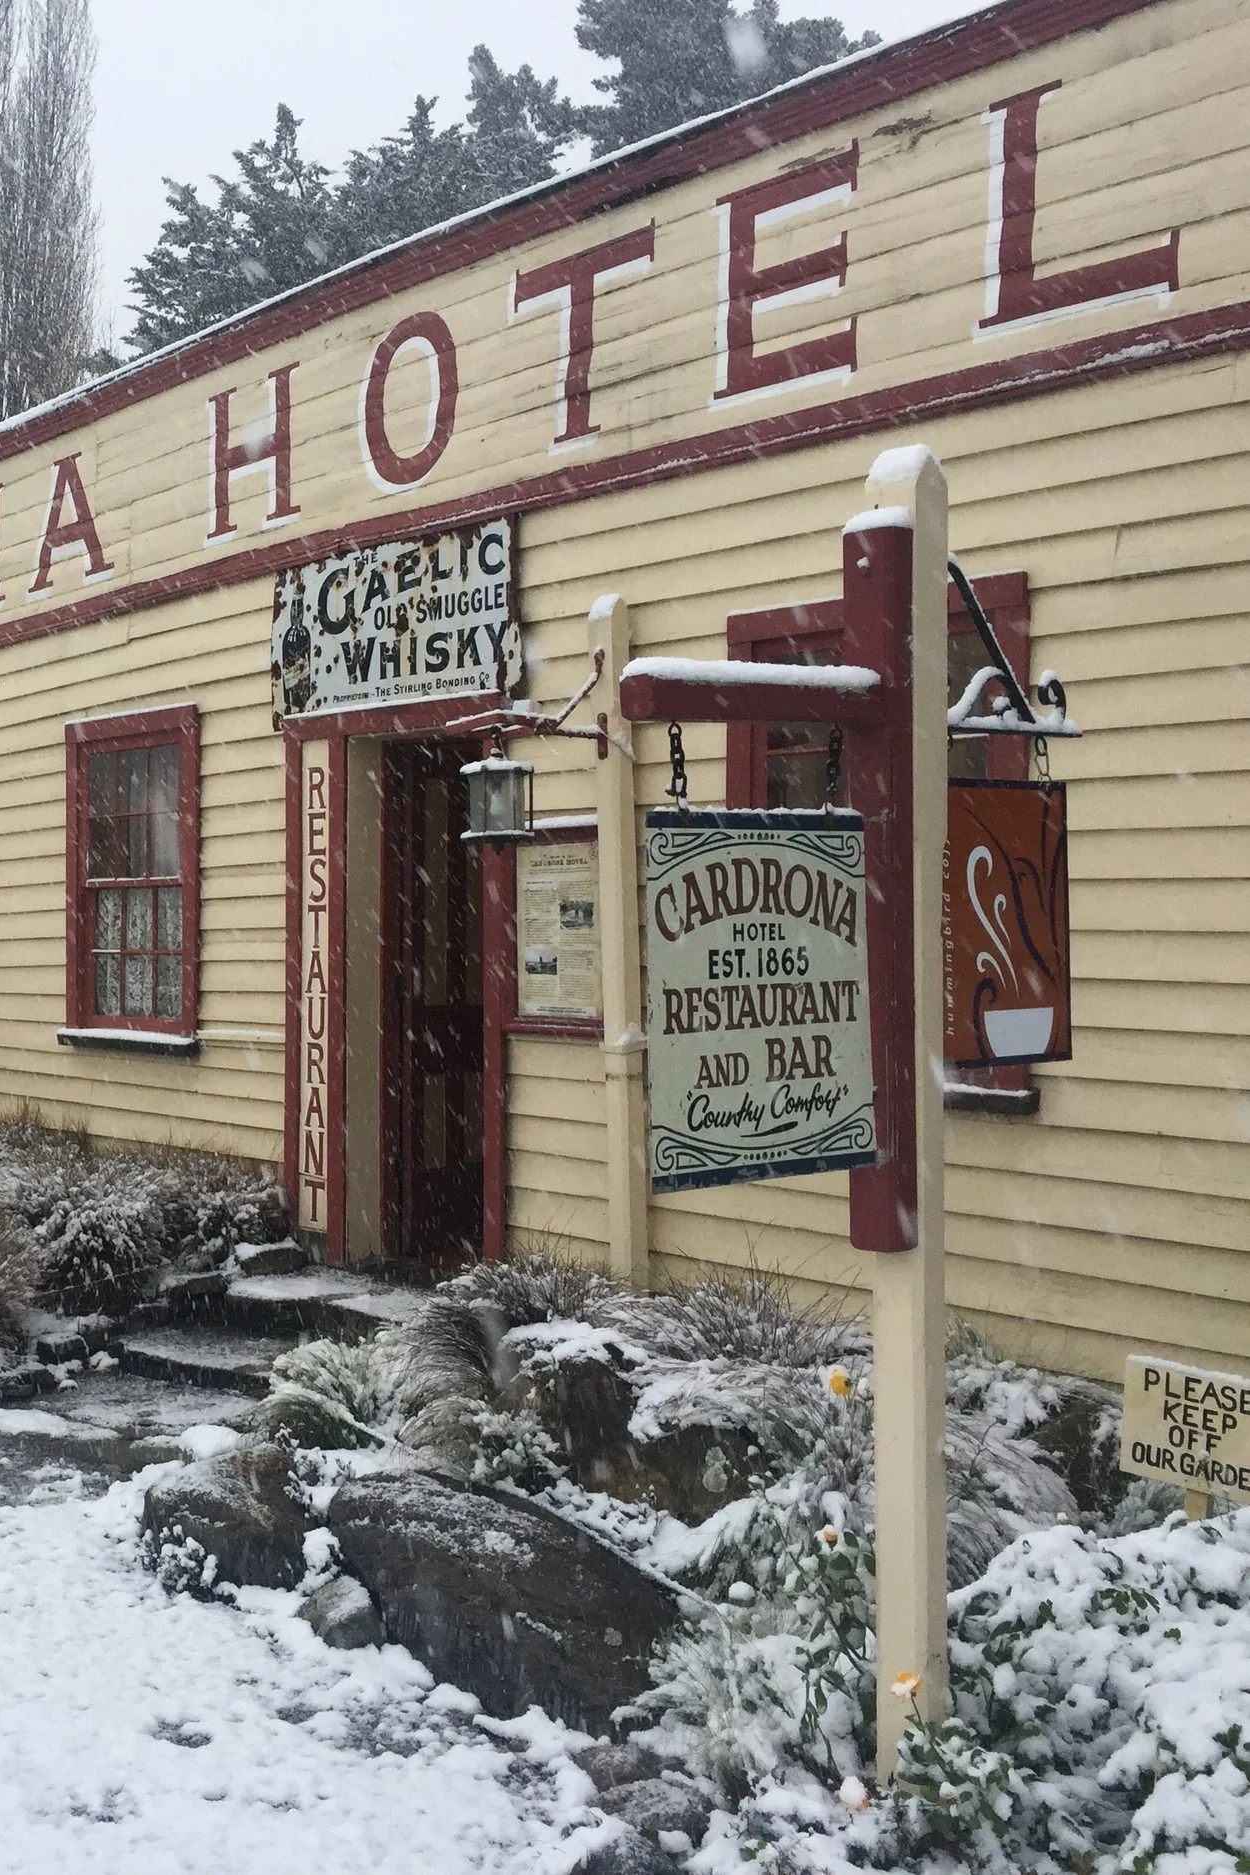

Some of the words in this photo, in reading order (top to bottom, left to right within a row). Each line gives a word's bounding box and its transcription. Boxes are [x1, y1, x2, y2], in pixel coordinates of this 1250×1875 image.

[205, 79, 1179, 544] HOTEL
[317, 533, 506, 635] GAELIC
[353, 552, 378, 566] THE
[416, 581, 510, 623] SMUGGLE
[341, 621, 508, 685] WHISKY
[394, 681, 432, 695] STIRLING
[436, 675, 476, 690] BONDING
[654, 857, 858, 948] CARDRONA
[732, 922, 786, 943] HOTEL
[708, 947, 750, 980] EST.
[757, 945, 810, 978] 1865
[305, 766, 327, 1223] RESTAURANT
[662, 980, 860, 1035] RESTAURANT
[694, 1052, 750, 1090] AND
[765, 1034, 837, 1083] BAR
[1144, 1367, 1250, 1416] PLEASE
[1163, 1399, 1238, 1435] KEEP
[1169, 1425, 1222, 1453] OFF
[1131, 1441, 1178, 1473] OUR
[1180, 1452, 1250, 1492] GARDE
